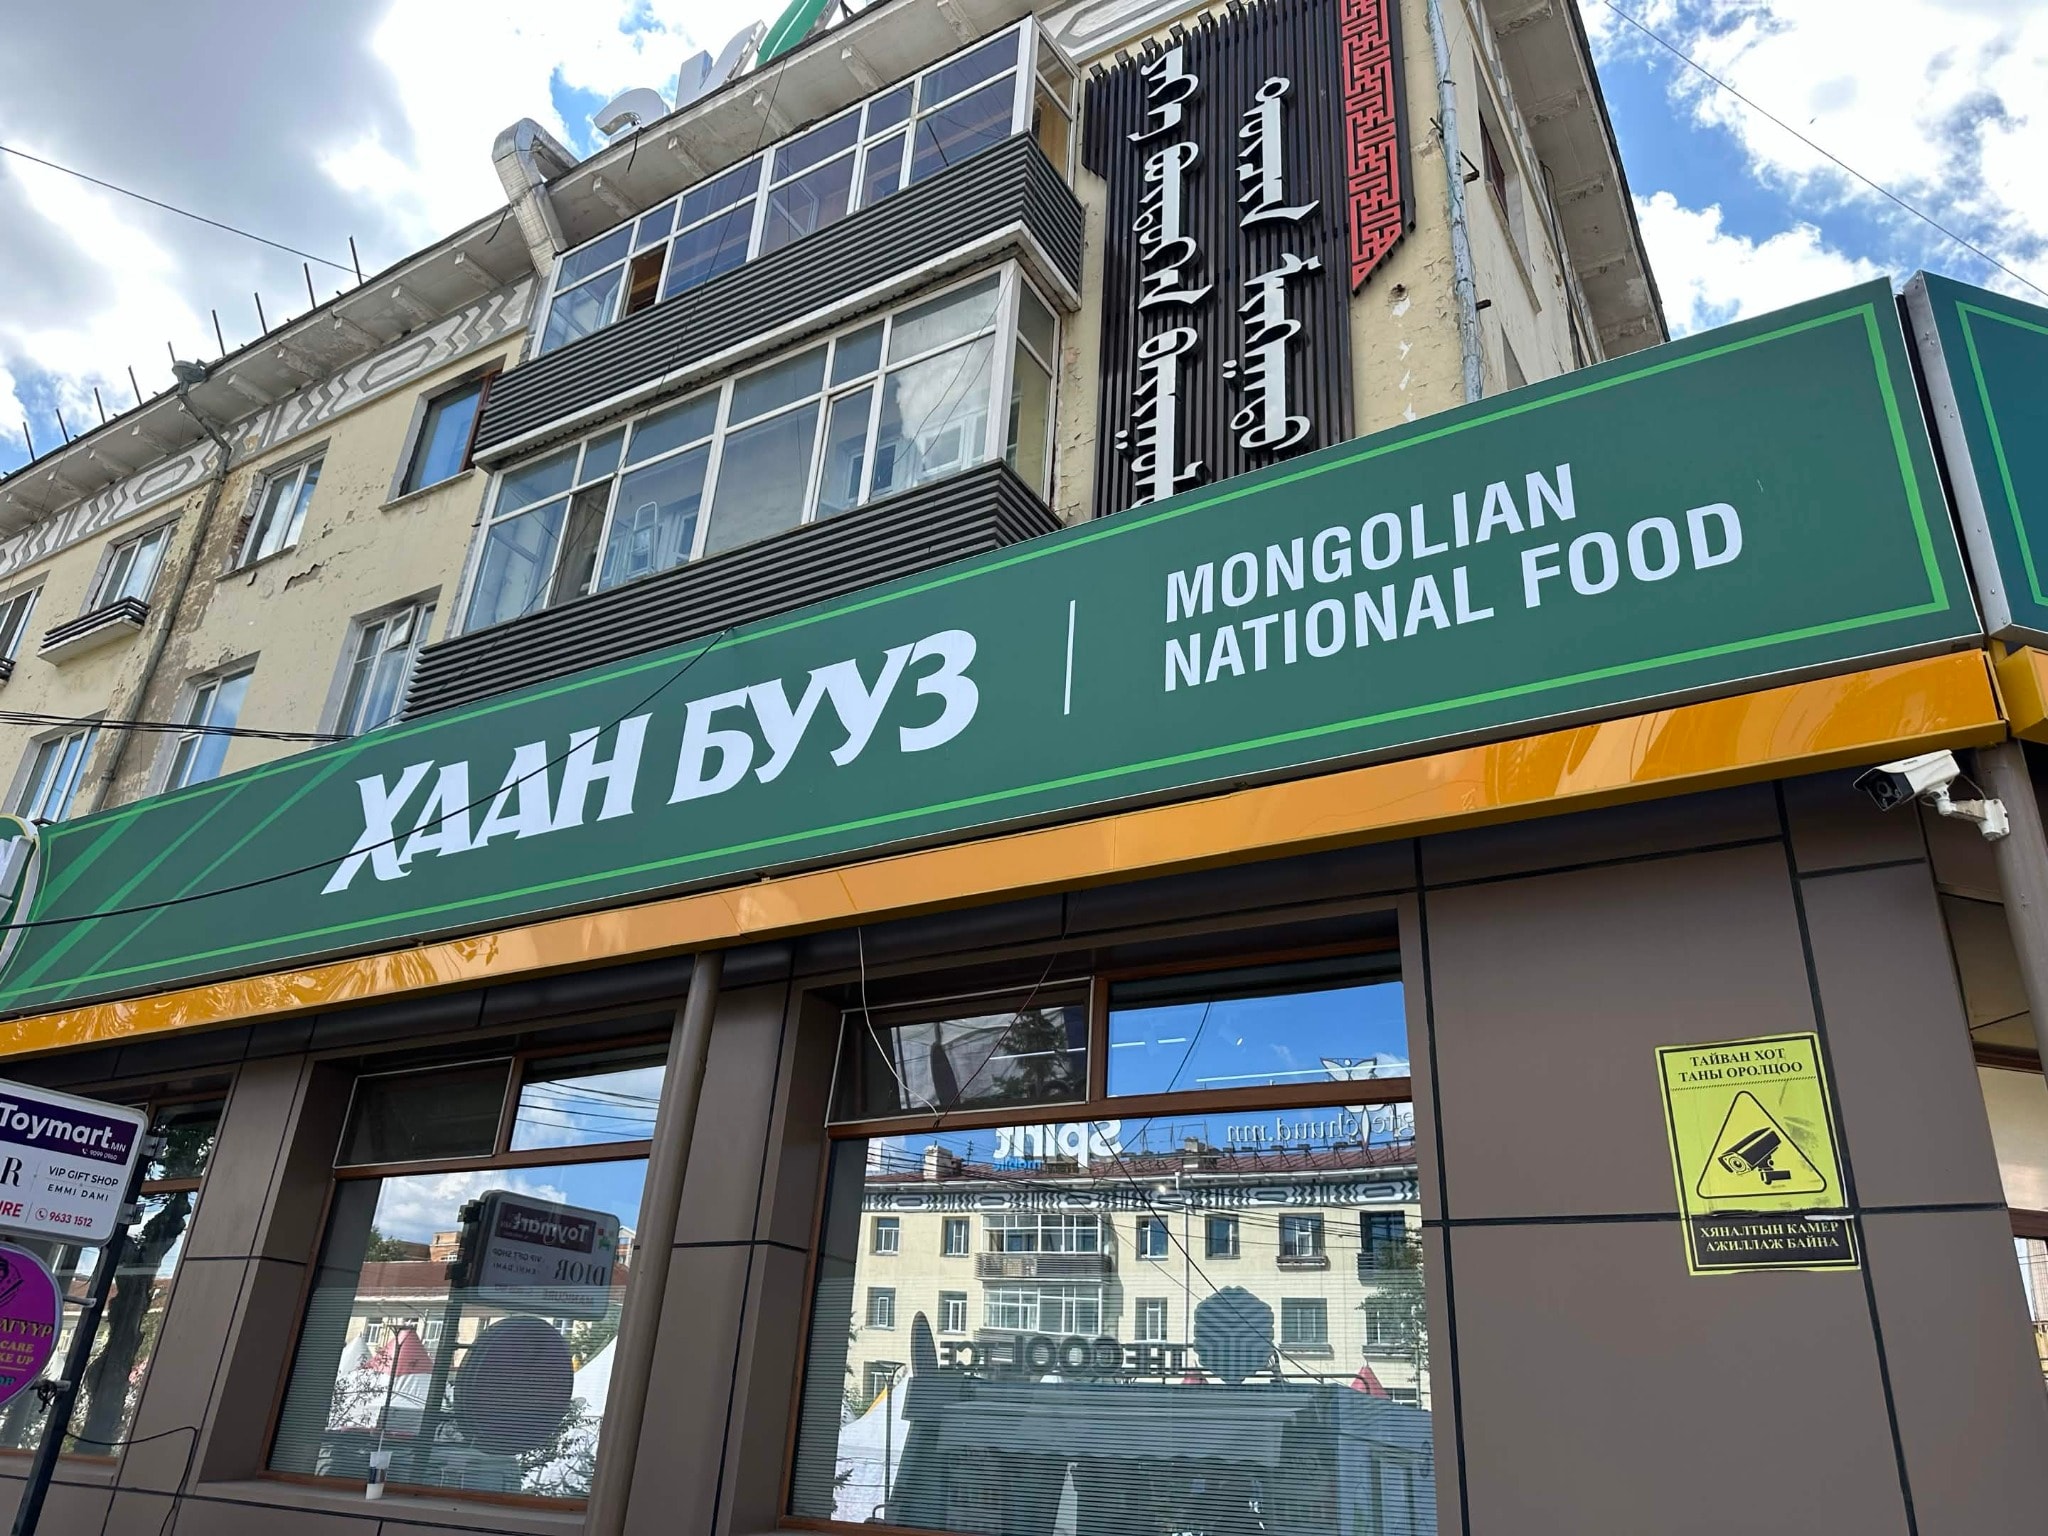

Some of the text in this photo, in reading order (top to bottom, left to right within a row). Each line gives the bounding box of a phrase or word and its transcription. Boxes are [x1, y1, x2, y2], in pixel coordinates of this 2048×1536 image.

[1165, 463, 1577, 624] MONGOLIAN
[1164, 503, 1743, 692] NATIONAL FOOD
[321, 629, 979, 895] ХААН БУУЗ
[1690, 1047, 1785, 1067] ТАЙВАН ХОТ
[1679, 1061, 1803, 1082] ТАНЫ ОРОЛЦОО
[49, 1165, 119, 1187] VIP GIFT SHOP
[48, 1184, 109, 1201] EMMI DAMI
[49, 1211, 93, 1227] 9633 1512
[1700, 1222, 1839, 1238] ХЯНАЛТЫН КАМЕР
[1706, 1235, 1840, 1252] АЖИЛЛАЖ БАЙНА
